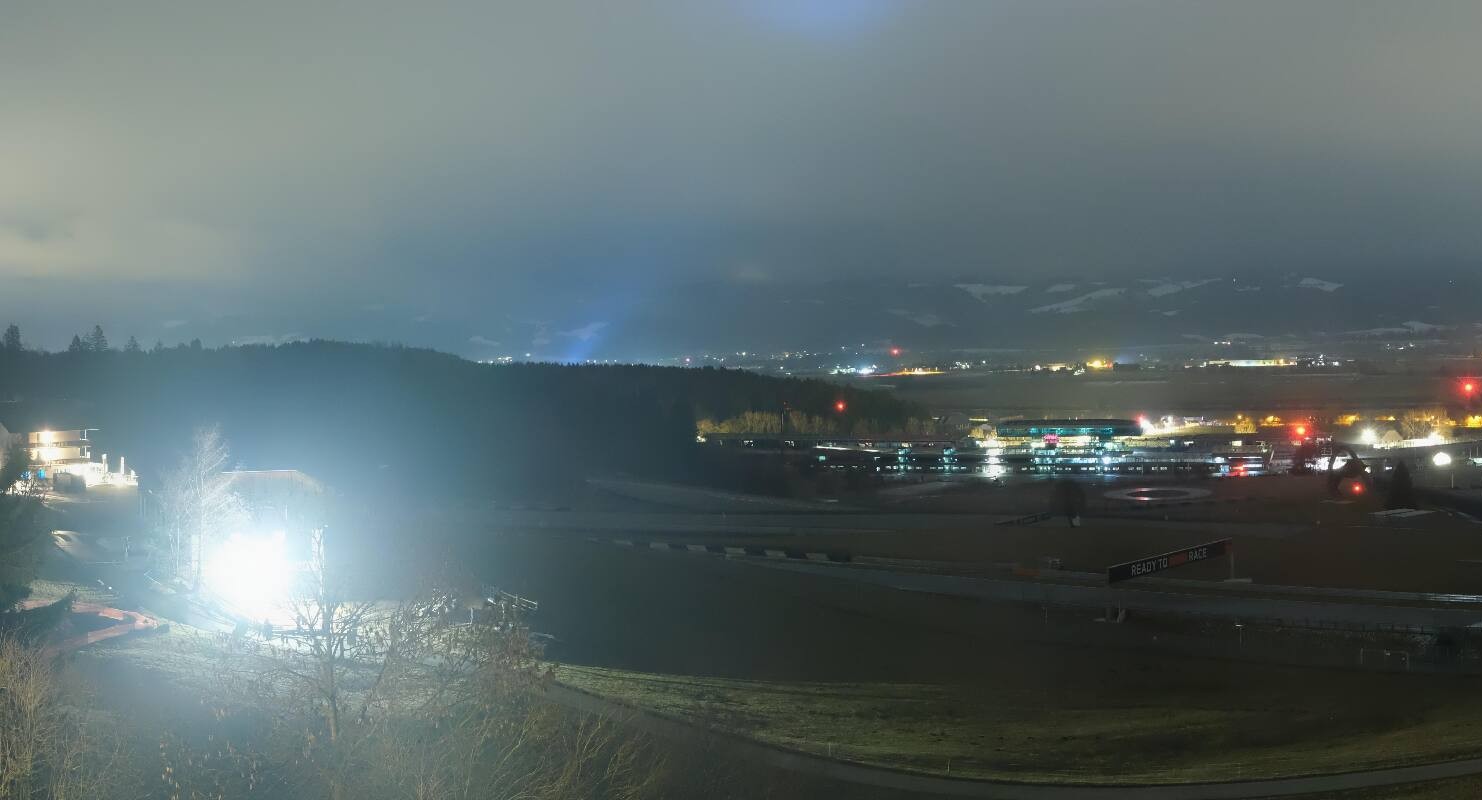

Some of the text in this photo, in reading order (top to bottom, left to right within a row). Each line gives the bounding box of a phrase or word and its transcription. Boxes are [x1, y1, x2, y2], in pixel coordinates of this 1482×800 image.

[1131, 560, 1157, 576] READY
[1158, 557, 1168, 569] TO
[1188, 547, 1208, 561] RACE
